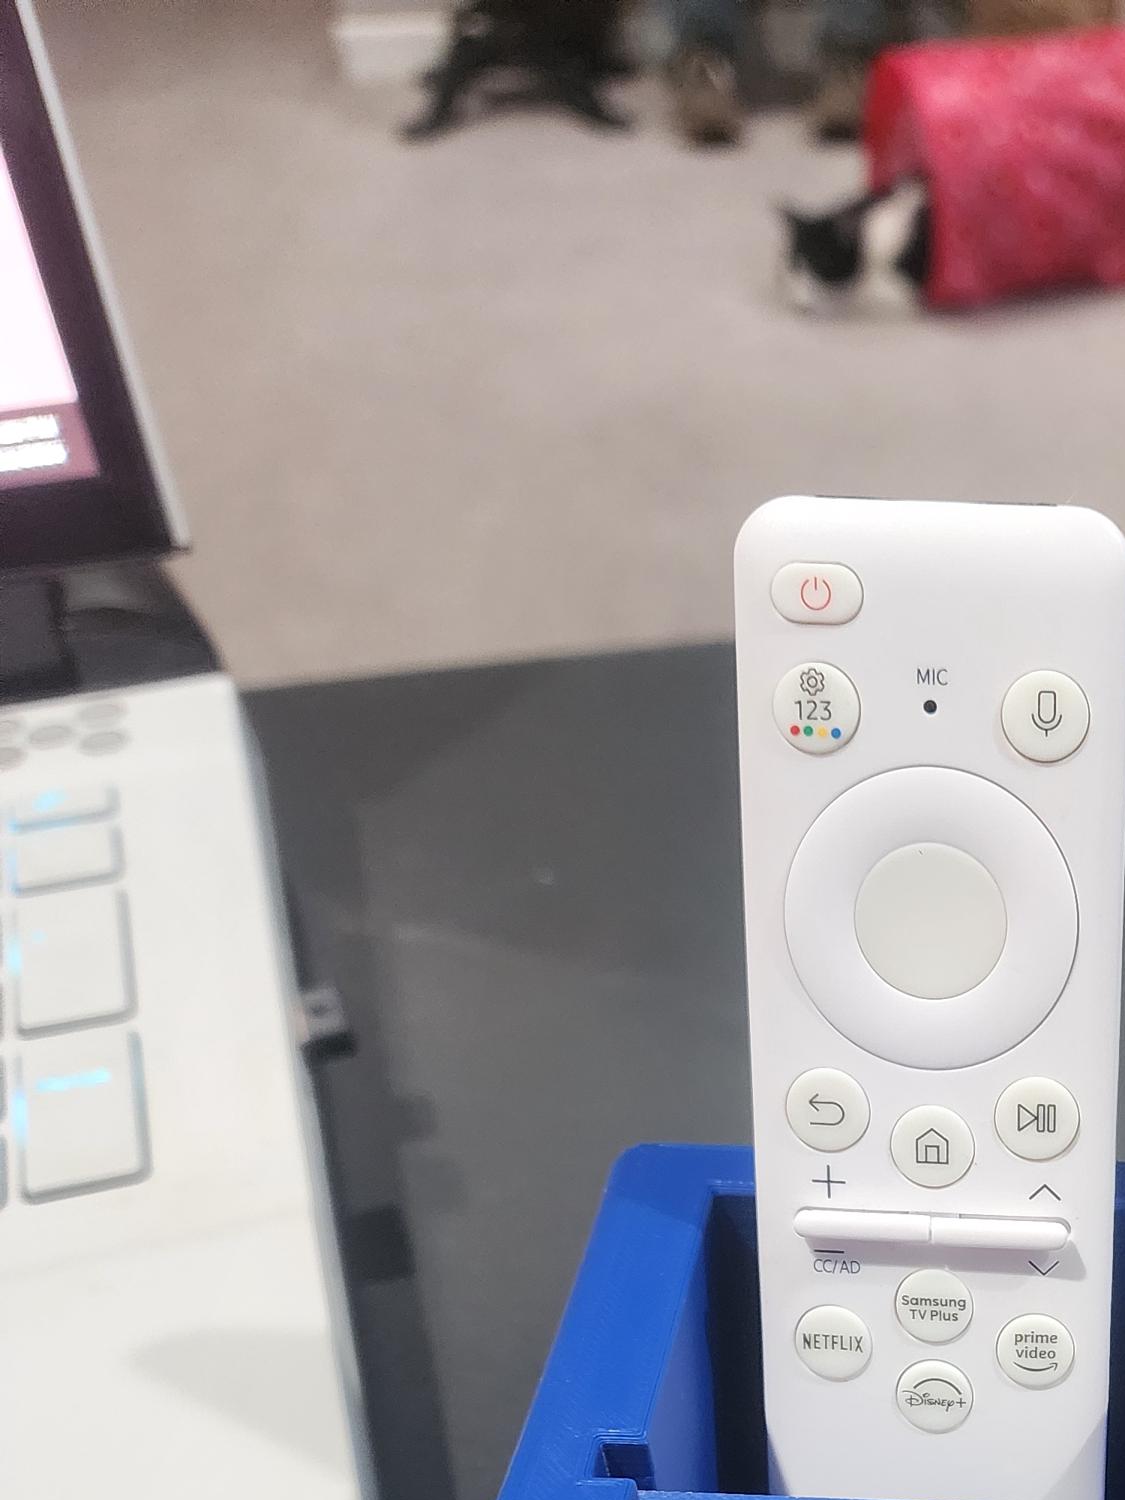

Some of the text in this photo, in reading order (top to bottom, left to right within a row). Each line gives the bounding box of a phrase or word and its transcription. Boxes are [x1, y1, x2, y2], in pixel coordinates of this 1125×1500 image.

[916, 668, 949, 687] MIC
[794, 700, 833, 721] 123
[812, 1258, 861, 1275] CC/AD
[901, 1294, 967, 1311] Samsung
[909, 1309, 959, 1322] TV Plus
[802, 1332, 864, 1353] NETFLIX
[1013, 1330, 1058, 1346] prime
[1015, 1346, 1057, 1360] video
